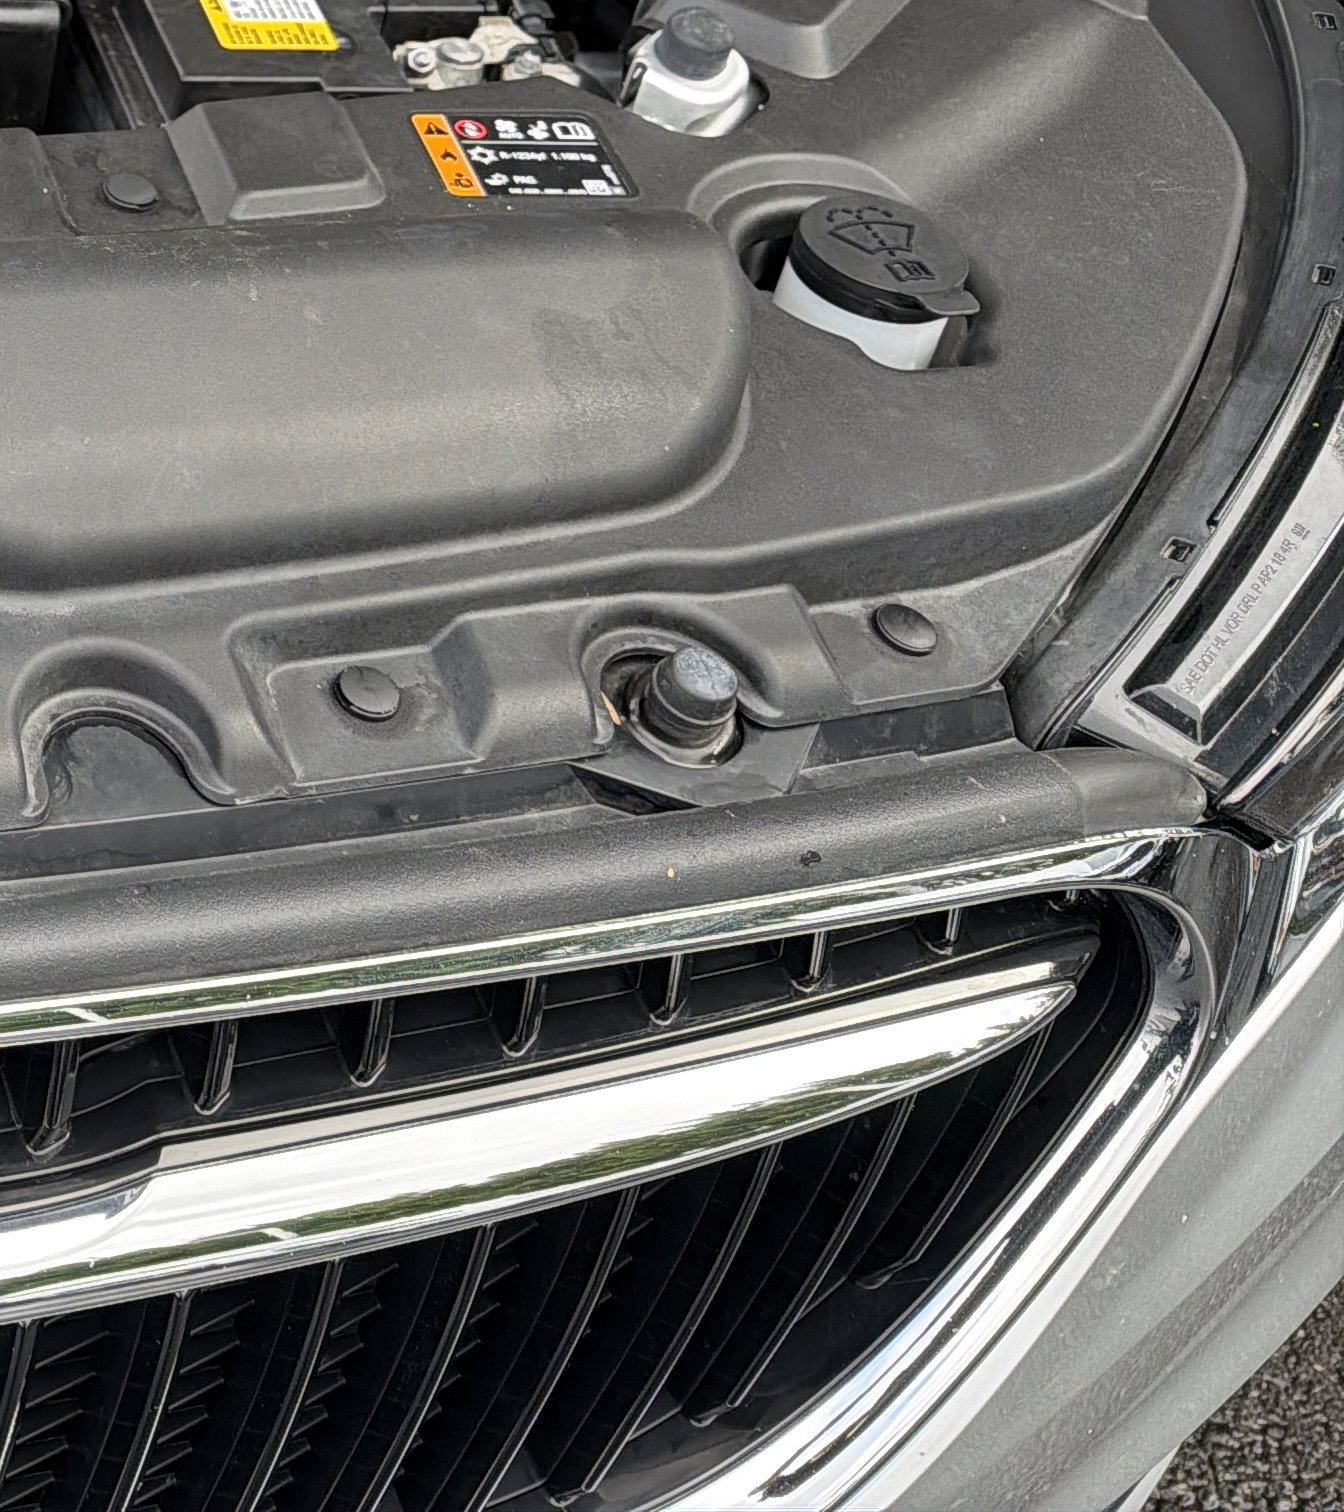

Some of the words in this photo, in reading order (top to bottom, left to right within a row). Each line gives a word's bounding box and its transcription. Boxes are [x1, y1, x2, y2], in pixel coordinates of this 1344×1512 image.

[1179, 668, 1203, 695] SAE
[1195, 647, 1218, 672] DOT
[1221, 611, 1245, 635] VOR
[1237, 593, 1259, 615] DRL
